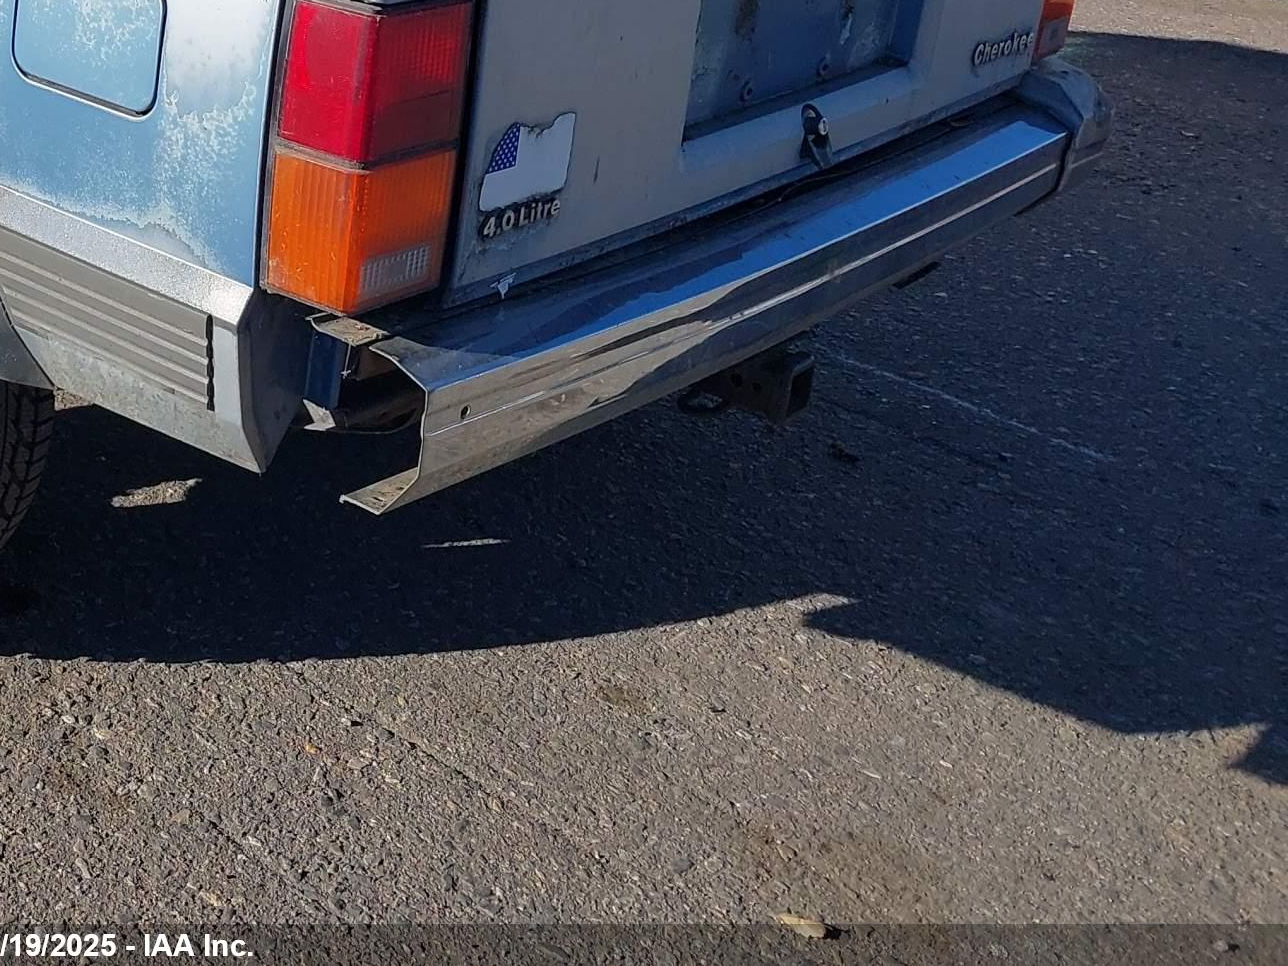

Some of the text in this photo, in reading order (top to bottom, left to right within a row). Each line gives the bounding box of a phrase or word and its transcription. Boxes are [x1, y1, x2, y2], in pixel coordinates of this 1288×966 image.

[973, 31, 1035, 67] Cherokee
[482, 199, 561, 238] 4.0 Litre
